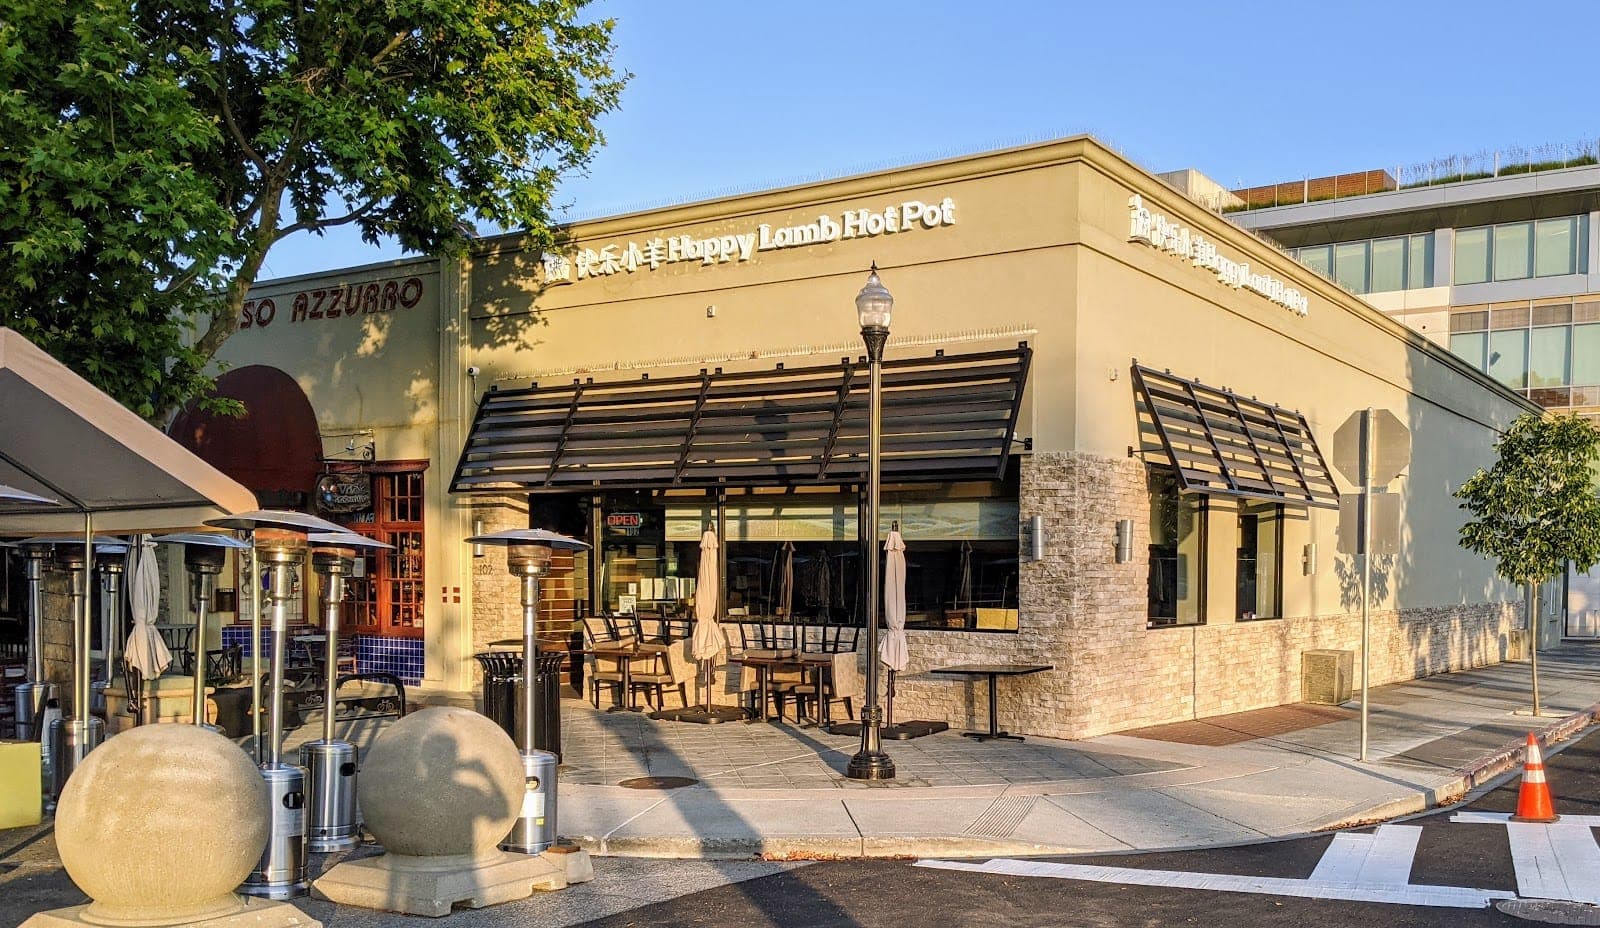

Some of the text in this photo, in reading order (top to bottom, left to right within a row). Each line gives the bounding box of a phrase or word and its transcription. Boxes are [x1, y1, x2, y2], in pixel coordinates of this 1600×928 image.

[575, 197, 956, 279] 快乐小羊 Happy Lamb Hot Pot
[239, 277, 424, 328] SO AZZURRO
[607, 515, 638, 526] OPEN
